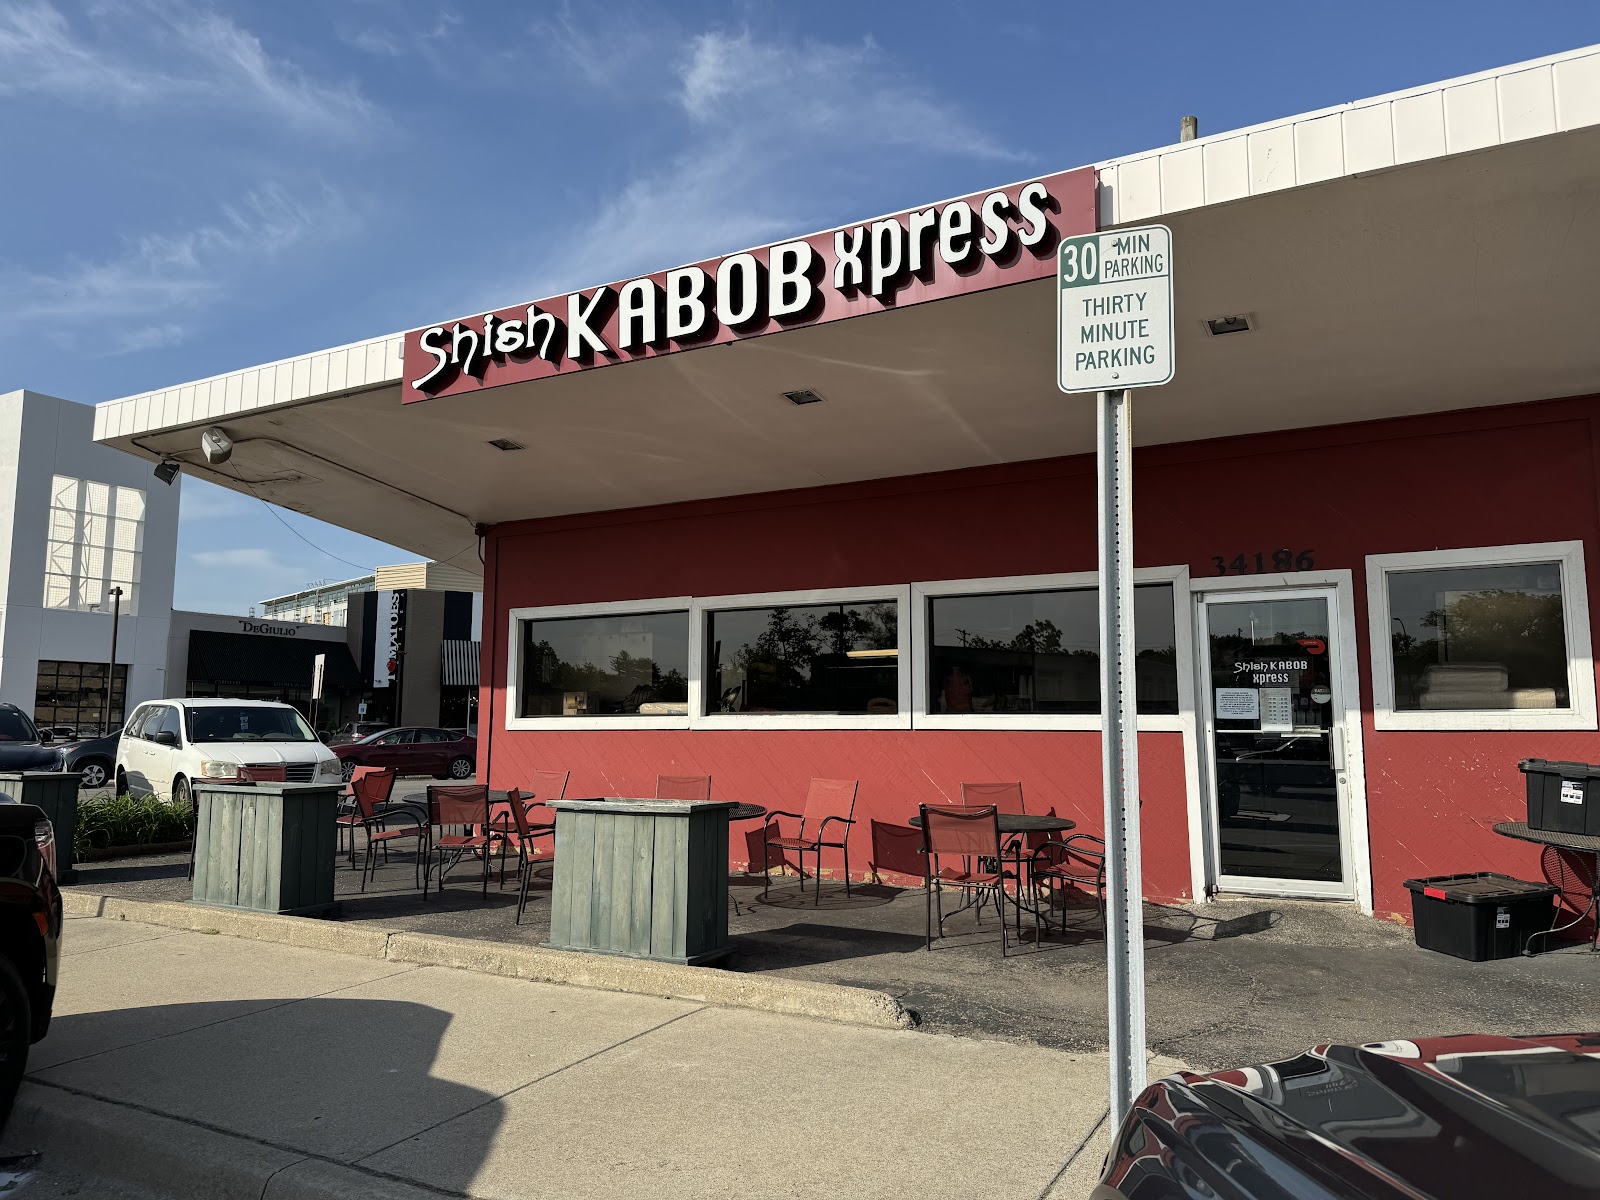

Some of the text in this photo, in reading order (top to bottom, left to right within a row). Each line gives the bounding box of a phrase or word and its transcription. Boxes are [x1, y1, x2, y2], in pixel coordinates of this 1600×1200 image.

[1117, 233, 1150, 256] MIN
[1063, 242, 1097, 282] 30
[1104, 253, 1163, 279] PARKING
[411, 181, 1049, 390] Shish KABOB xpress
[1082, 291, 1148, 317] THIRTY
[1080, 319, 1150, 344] MINUTE
[1075, 345, 1155, 371] PARKING
[1211, 549, 1316, 577] 34186
[1233, 660, 1308, 674] Shish KABOB
